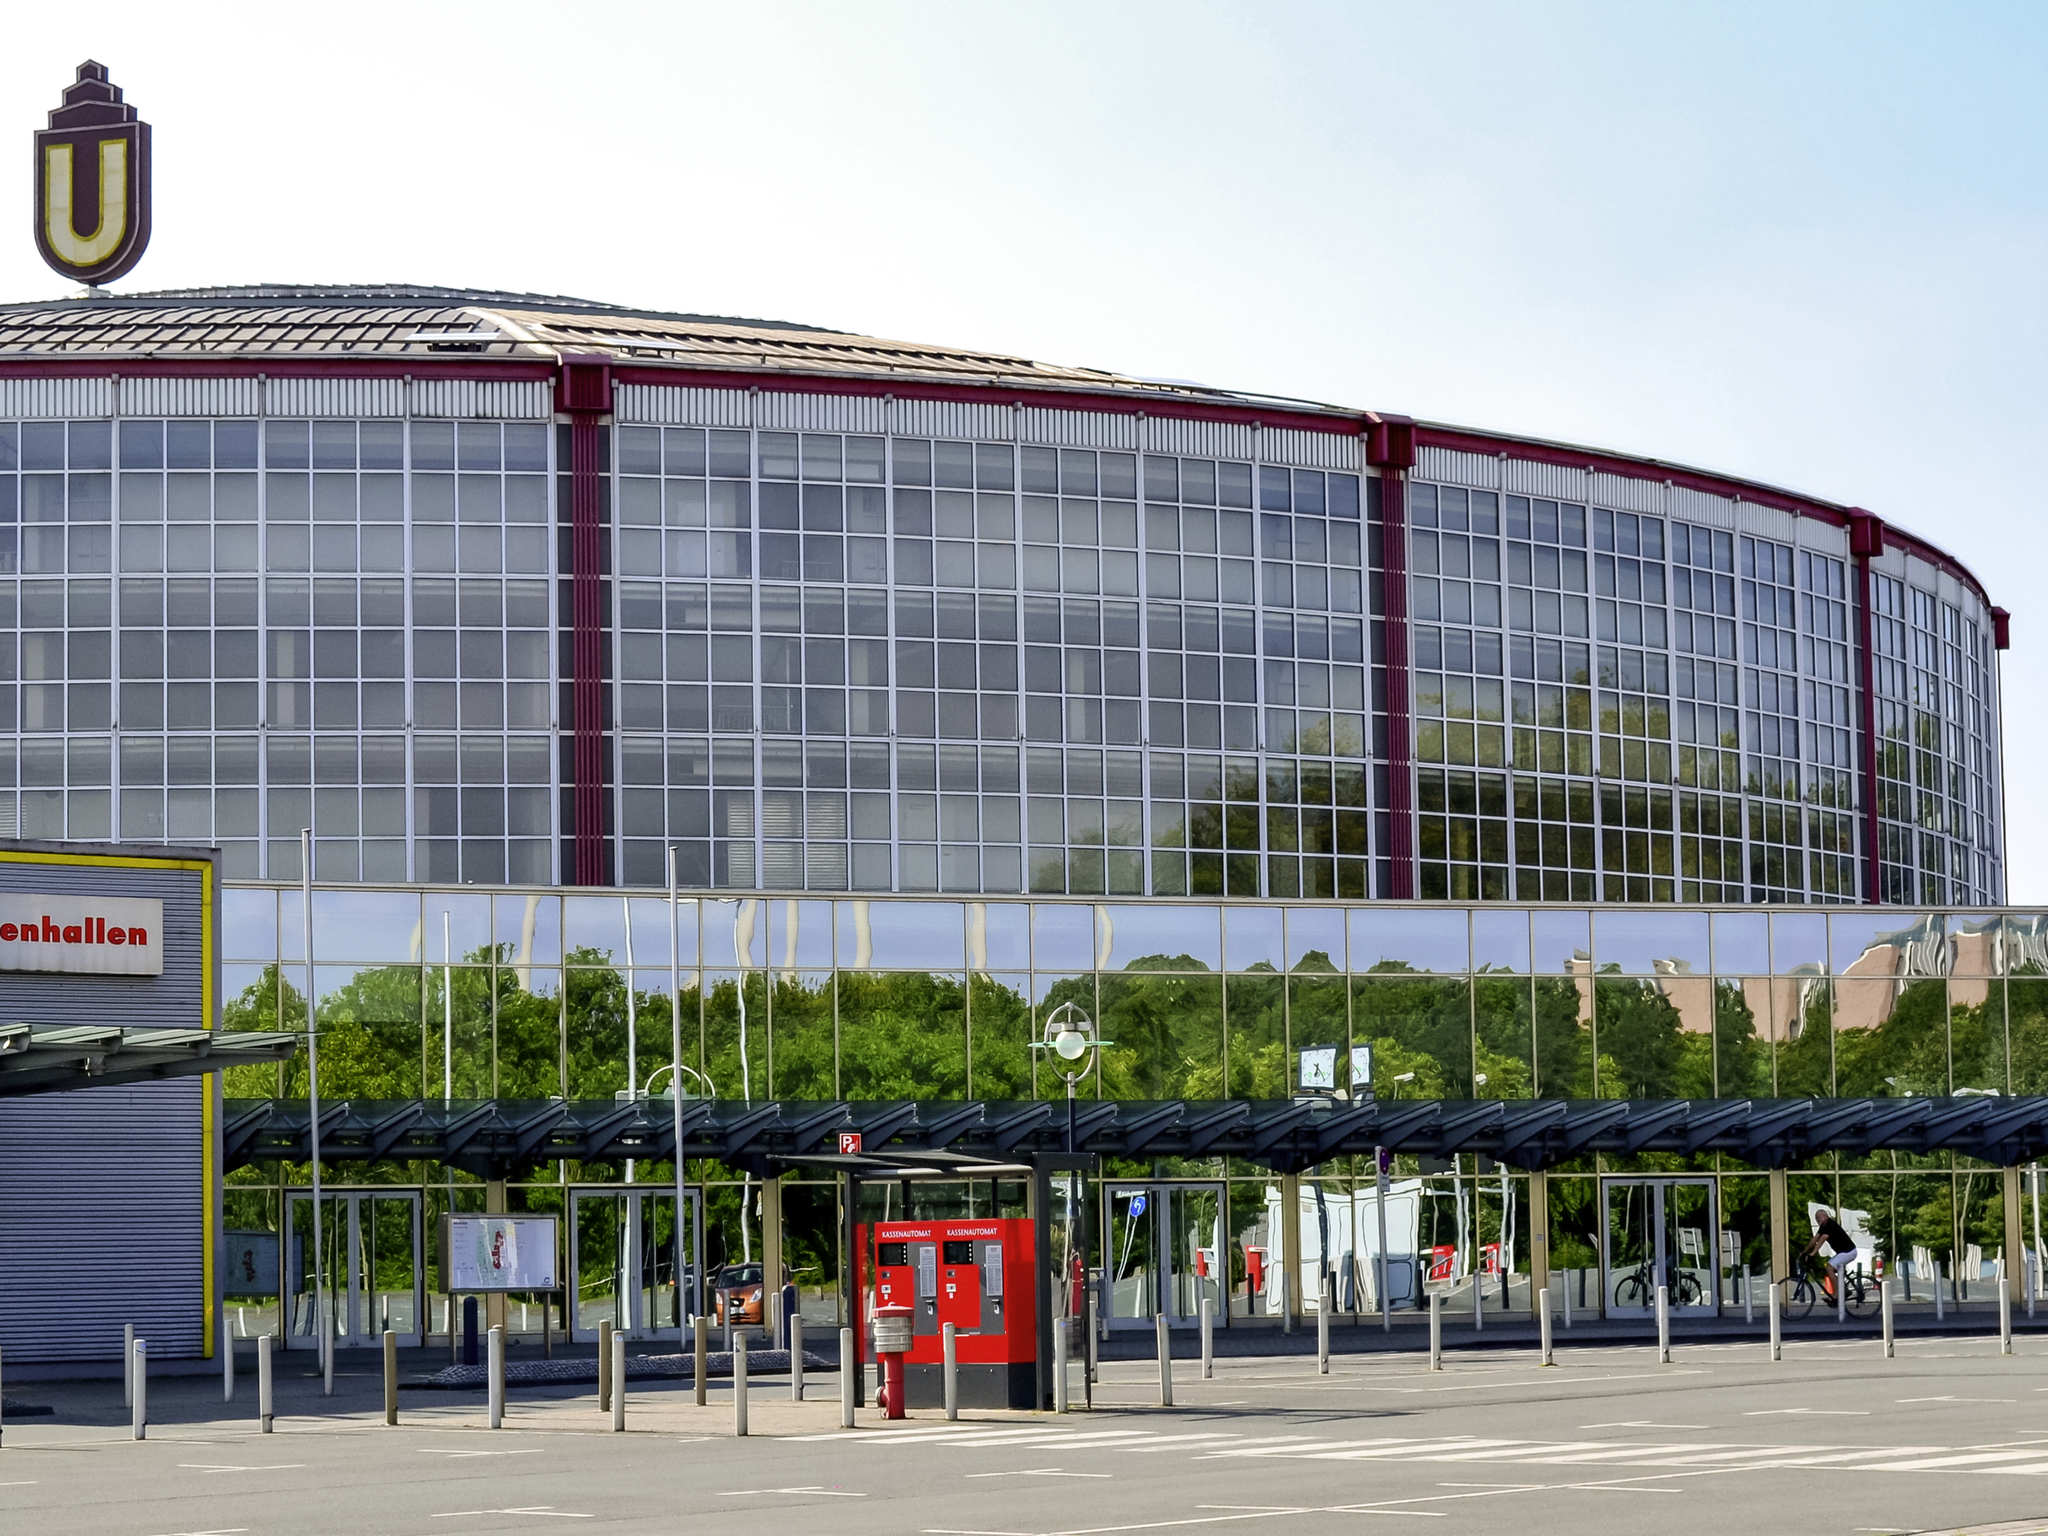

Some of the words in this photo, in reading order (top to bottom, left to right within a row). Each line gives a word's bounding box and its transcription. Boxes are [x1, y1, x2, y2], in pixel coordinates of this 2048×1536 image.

[45, 138, 128, 268] U
[0, 915, 148, 946] enhallen
[842, 1135, 852, 1148] P
[881, 1230, 931, 1238] KASSENAUTOMAT
[947, 1228, 997, 1236] KASSENAUTOMAT
